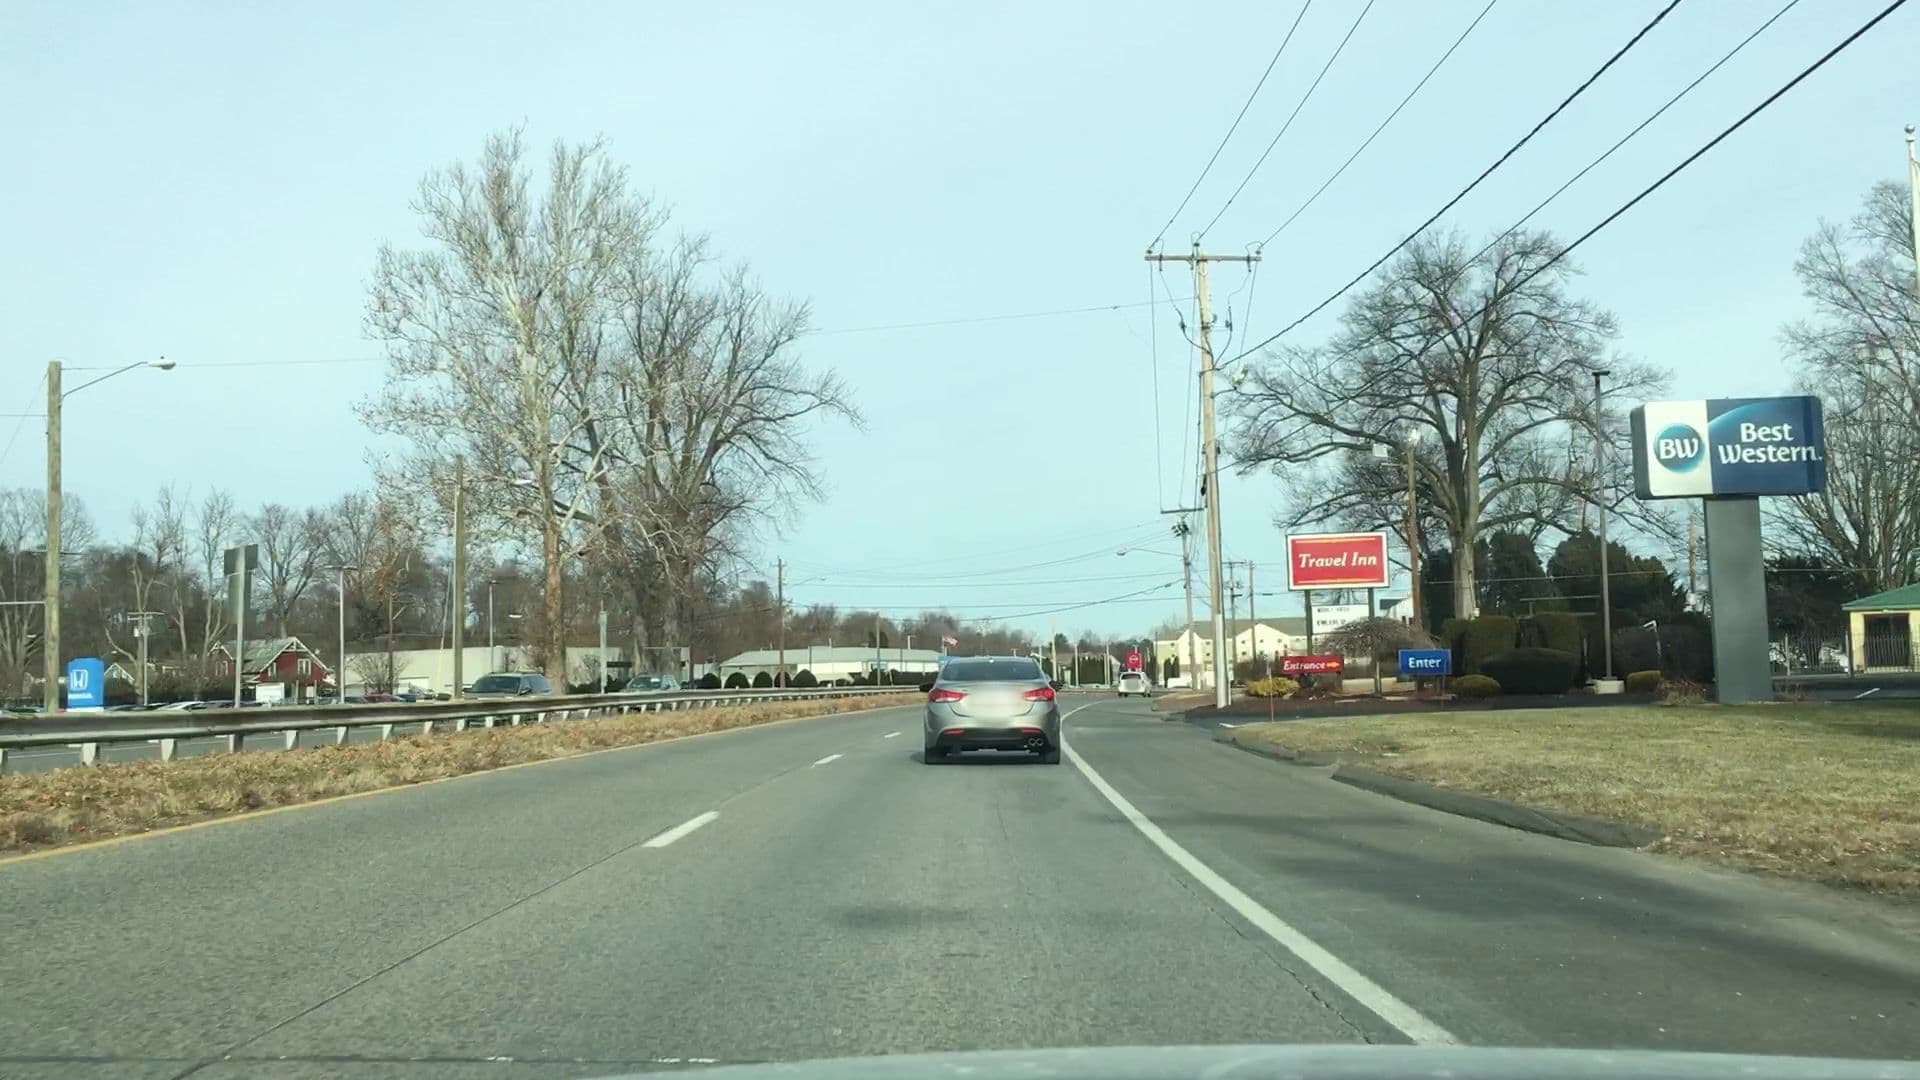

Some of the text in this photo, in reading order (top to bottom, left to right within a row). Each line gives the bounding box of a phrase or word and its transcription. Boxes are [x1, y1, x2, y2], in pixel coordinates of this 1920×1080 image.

[1740, 422, 1793, 443] Best
[1659, 437, 1699, 460] BW
[1298, 551, 1377, 568] Travel Inn
[1283, 659, 1326, 671] Entrance
[1408, 657, 1441, 669] Enter
